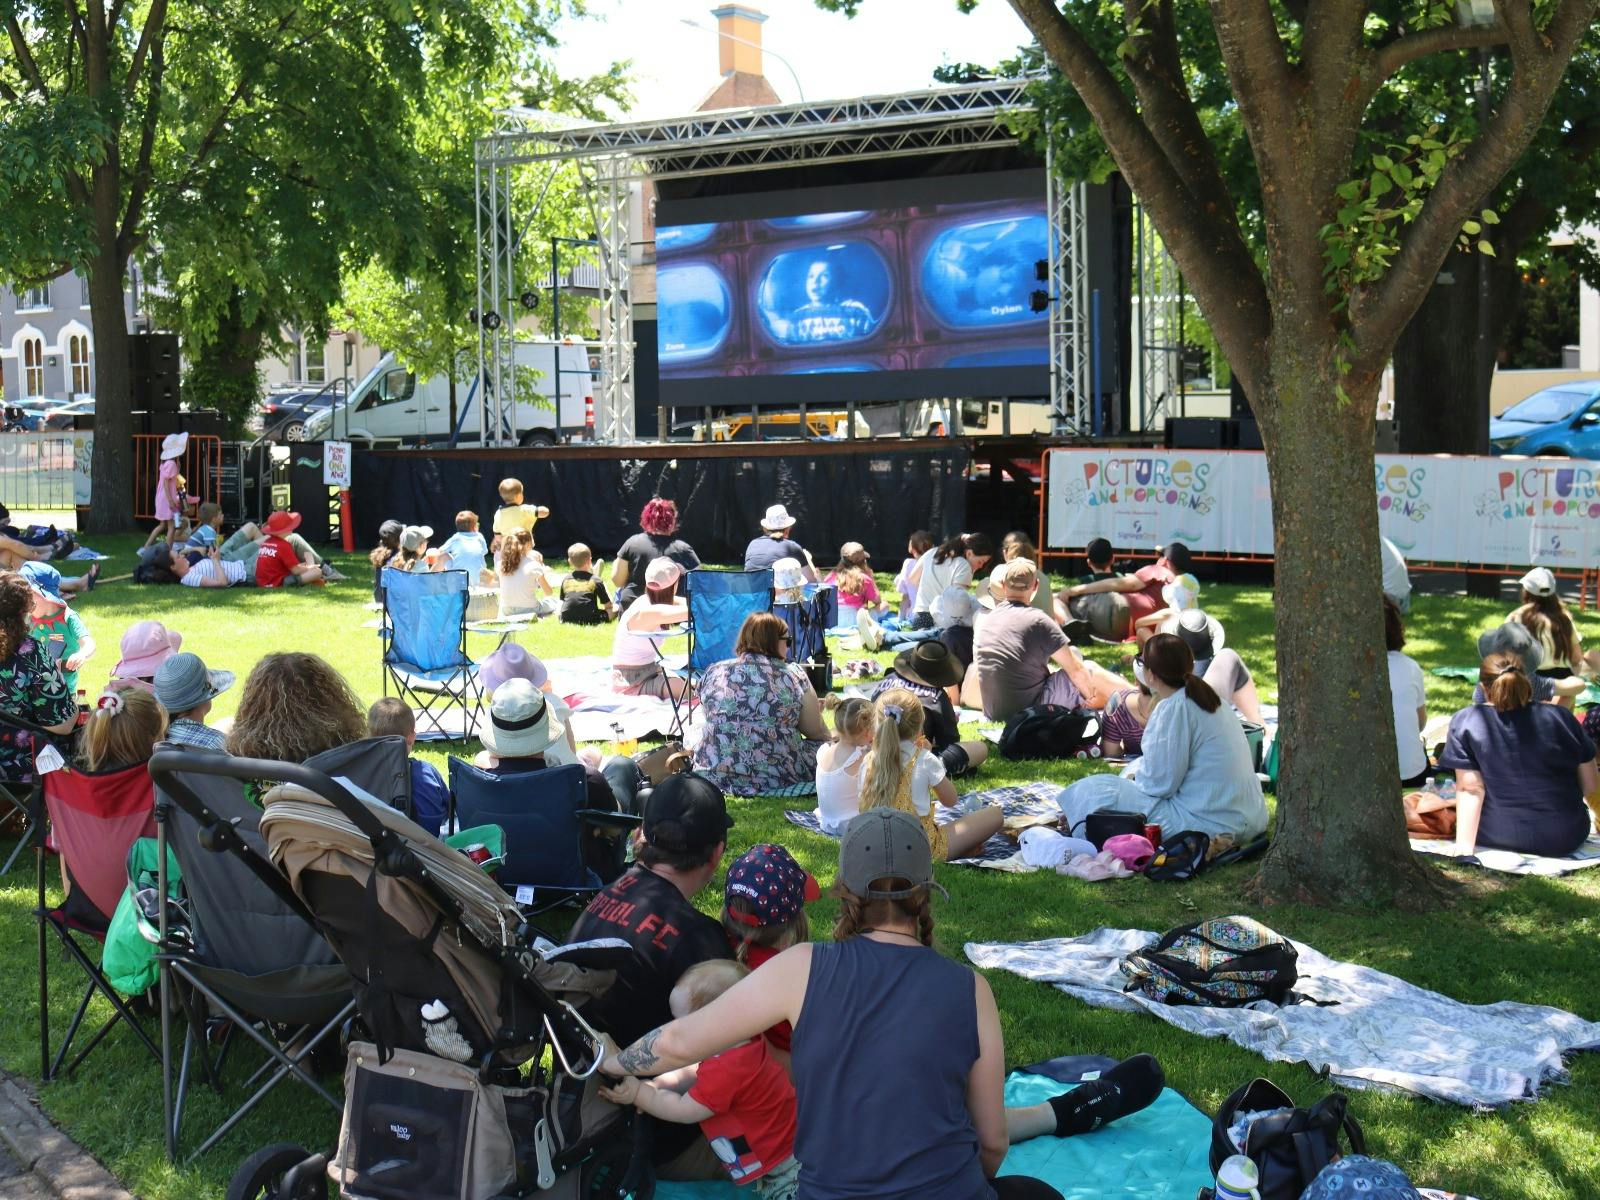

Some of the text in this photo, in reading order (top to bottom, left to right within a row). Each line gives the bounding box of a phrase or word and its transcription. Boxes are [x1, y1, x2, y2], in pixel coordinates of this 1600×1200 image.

[991, 304, 1023, 316] Dylan
[1124, 487, 1201, 511] POPCORN
[634, 913, 680, 951] FC
